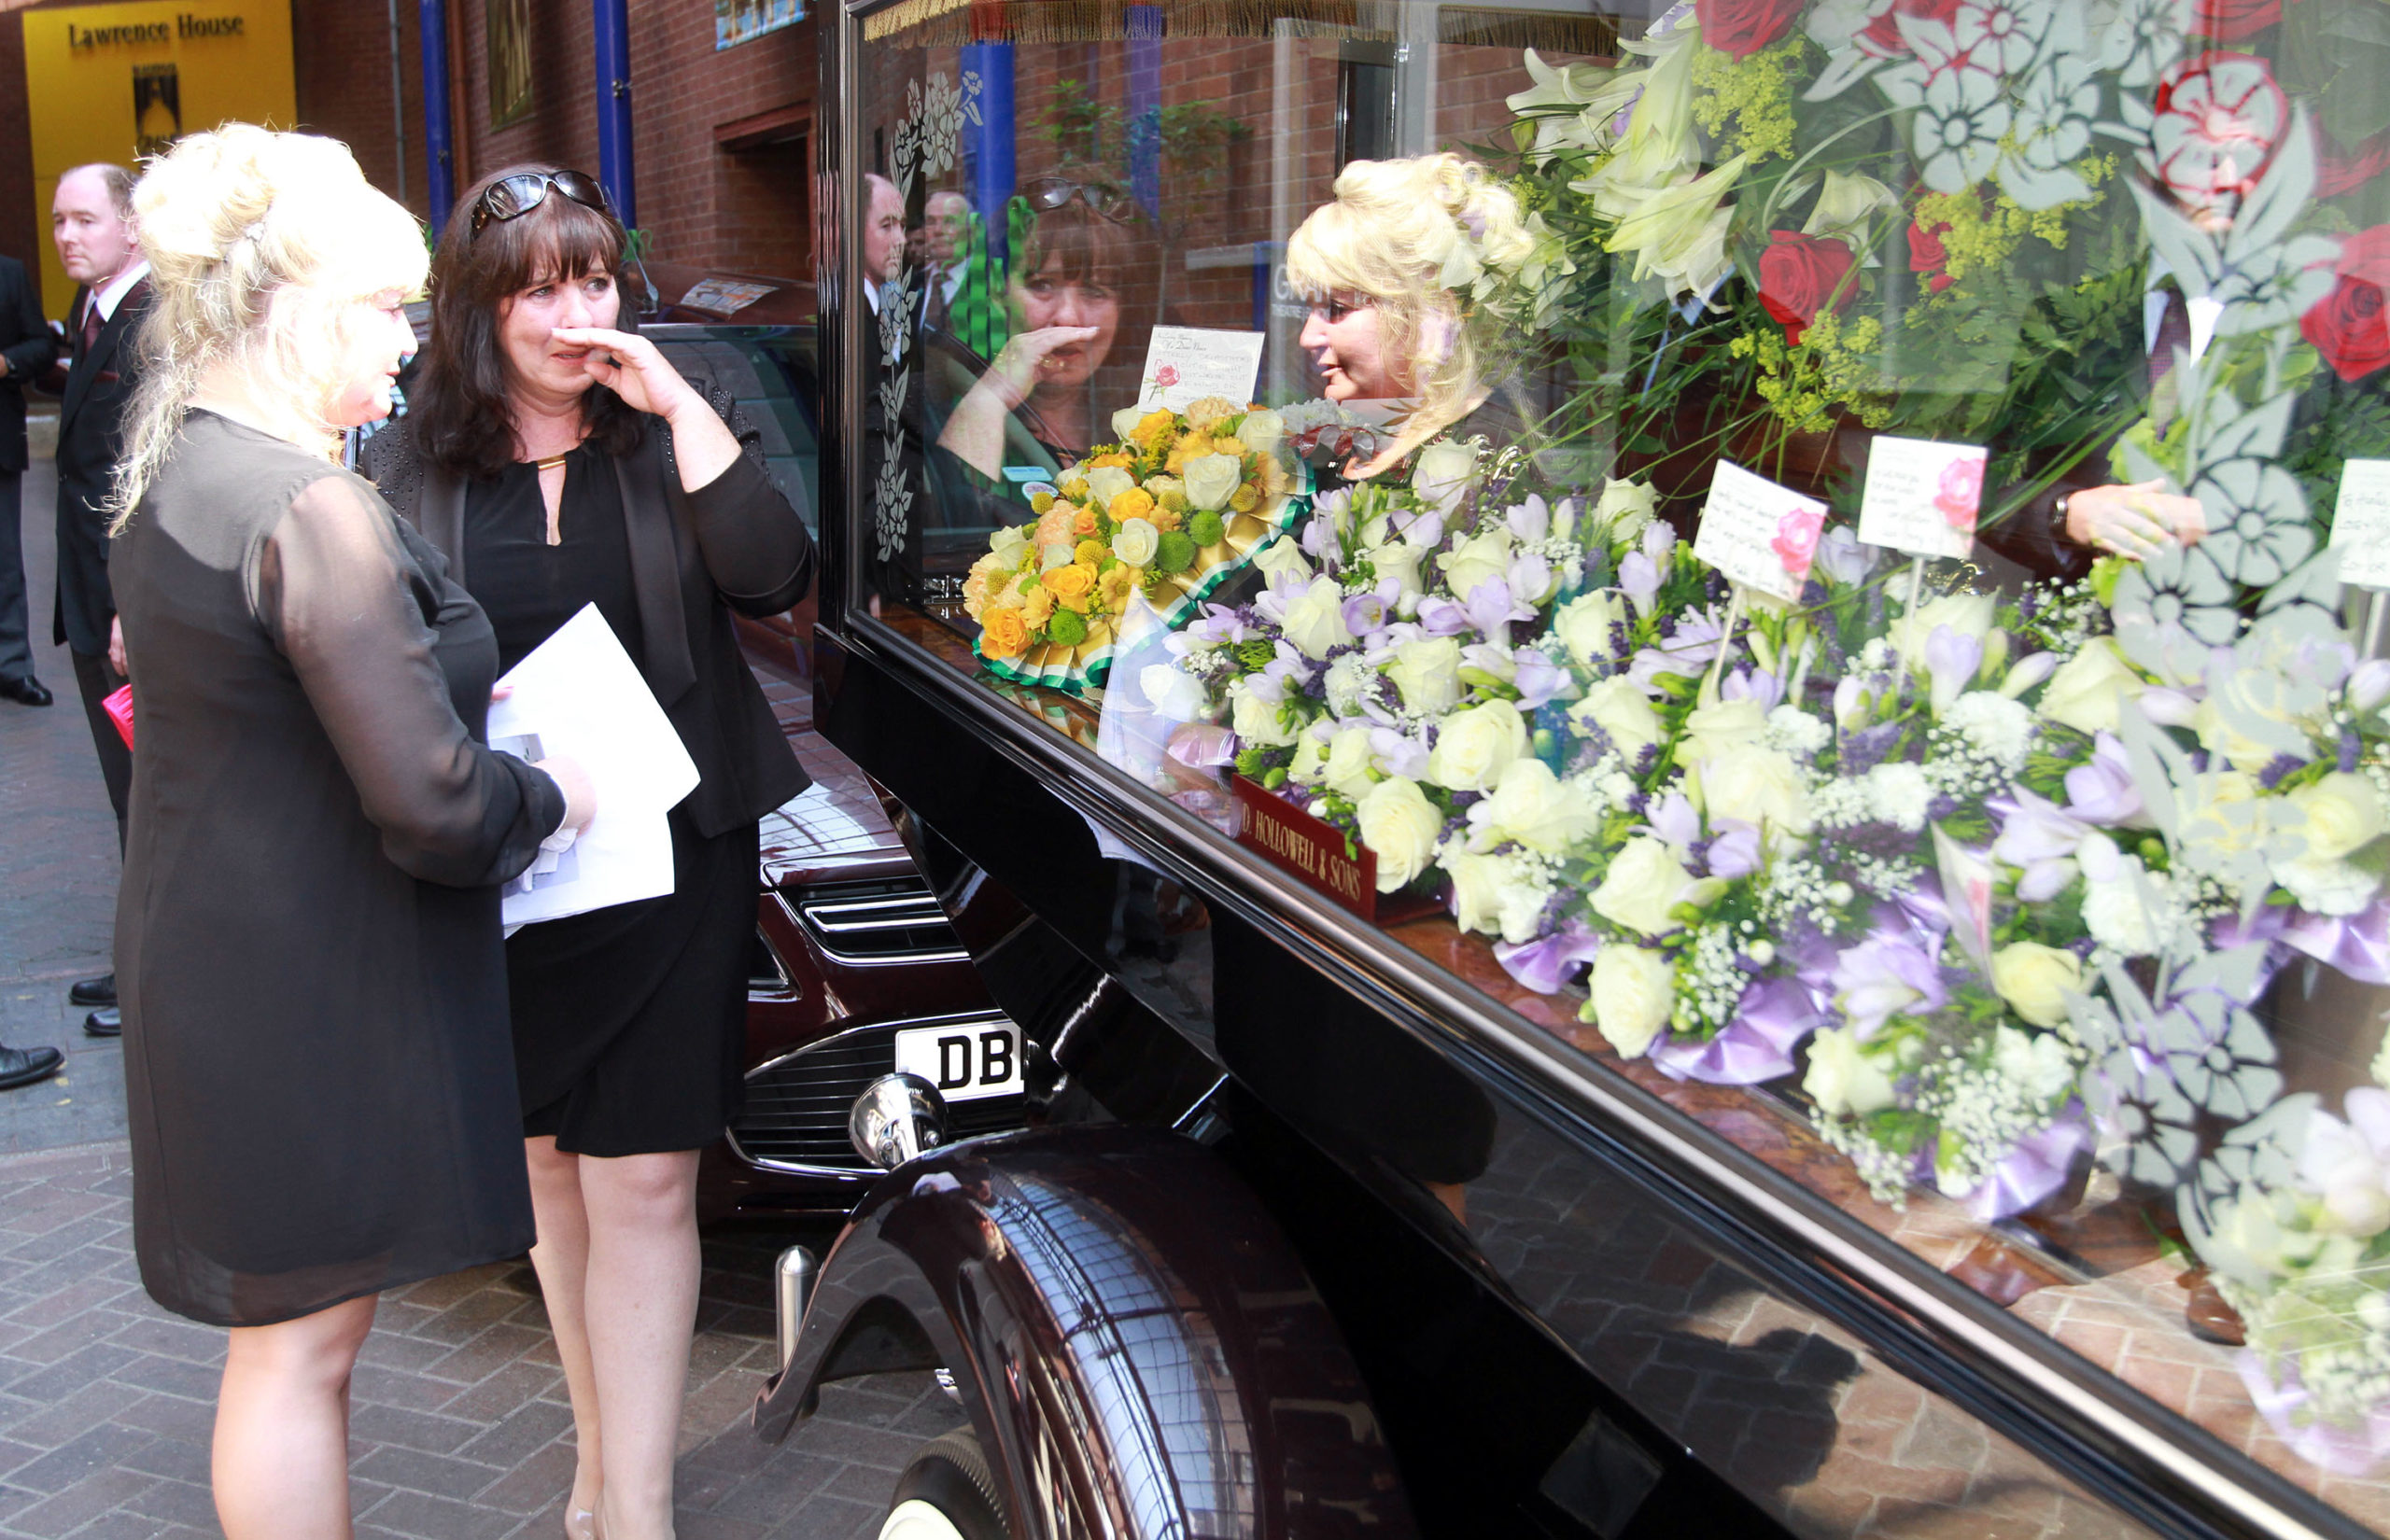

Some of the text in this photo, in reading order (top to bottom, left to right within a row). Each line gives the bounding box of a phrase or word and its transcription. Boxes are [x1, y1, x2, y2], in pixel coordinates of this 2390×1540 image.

[69, 14, 244, 48] Lawrence House
[1243, 803, 1361, 902] D. HOLLOWELL & SONS
[937, 1029, 1024, 1090] DB
